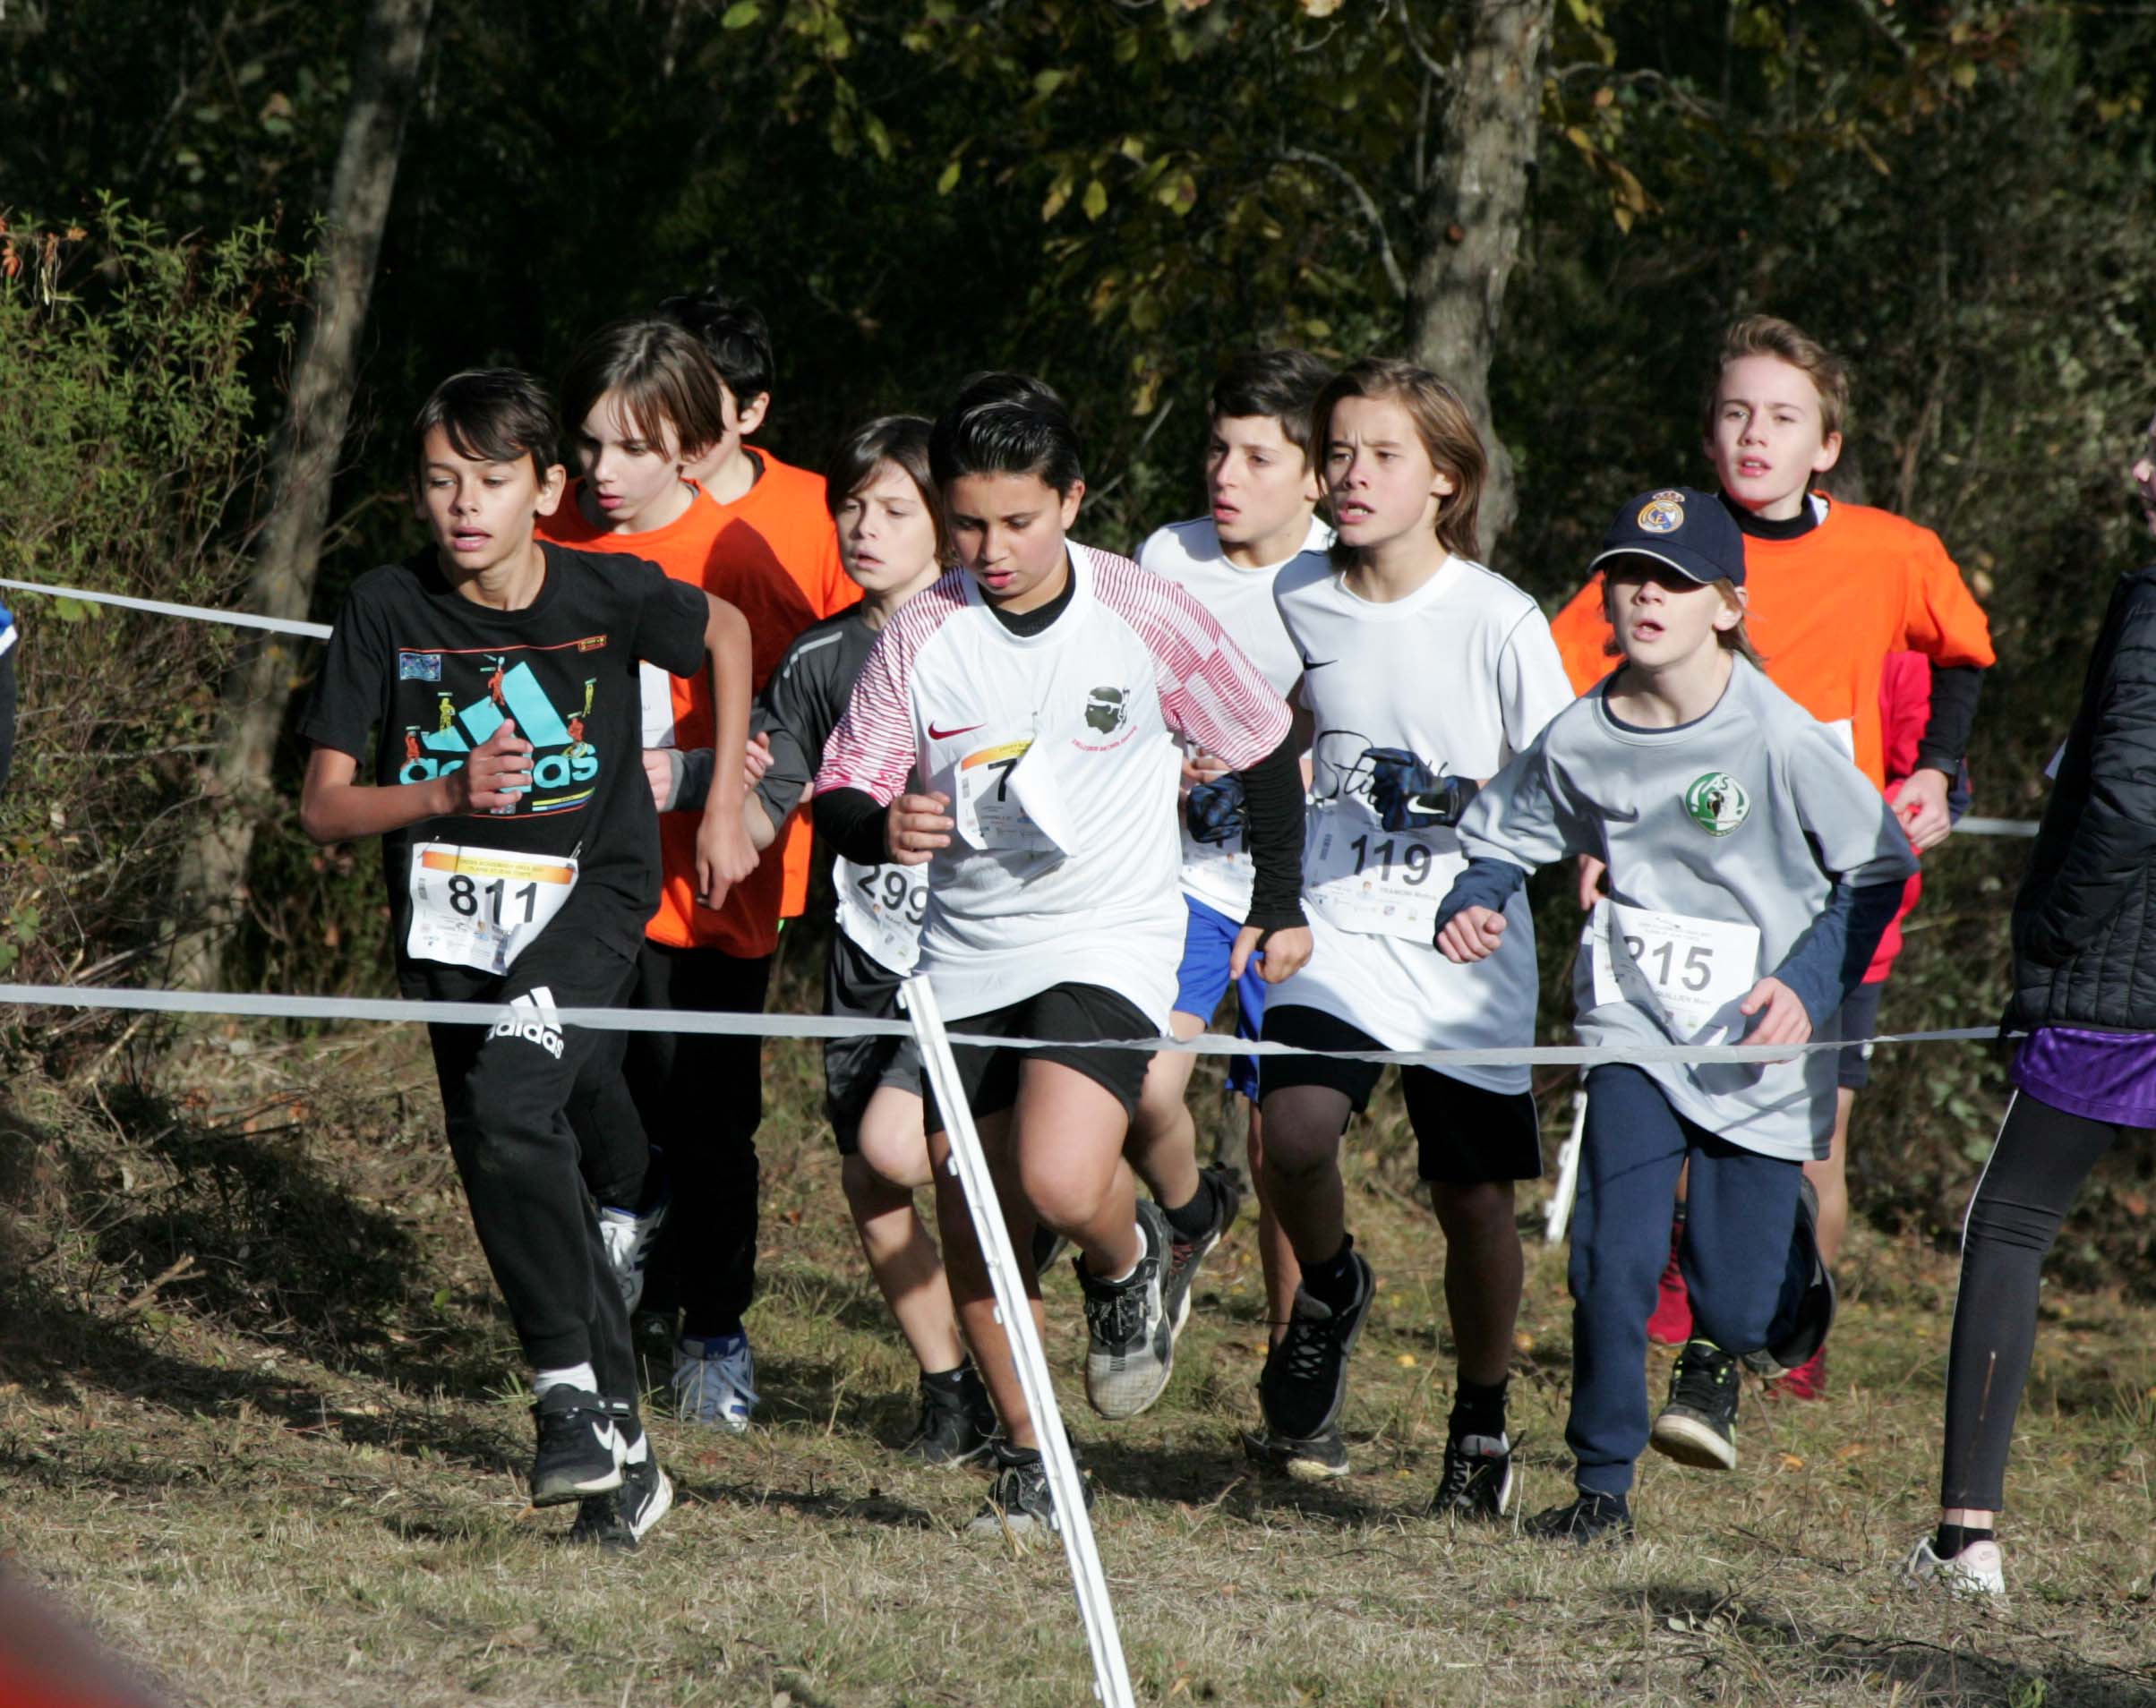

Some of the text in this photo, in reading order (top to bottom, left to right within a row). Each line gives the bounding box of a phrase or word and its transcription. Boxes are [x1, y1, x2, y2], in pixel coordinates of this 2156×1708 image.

[1351, 834, 1433, 885] 119
[448, 874, 539, 925] 811
[857, 865, 929, 926] 299
